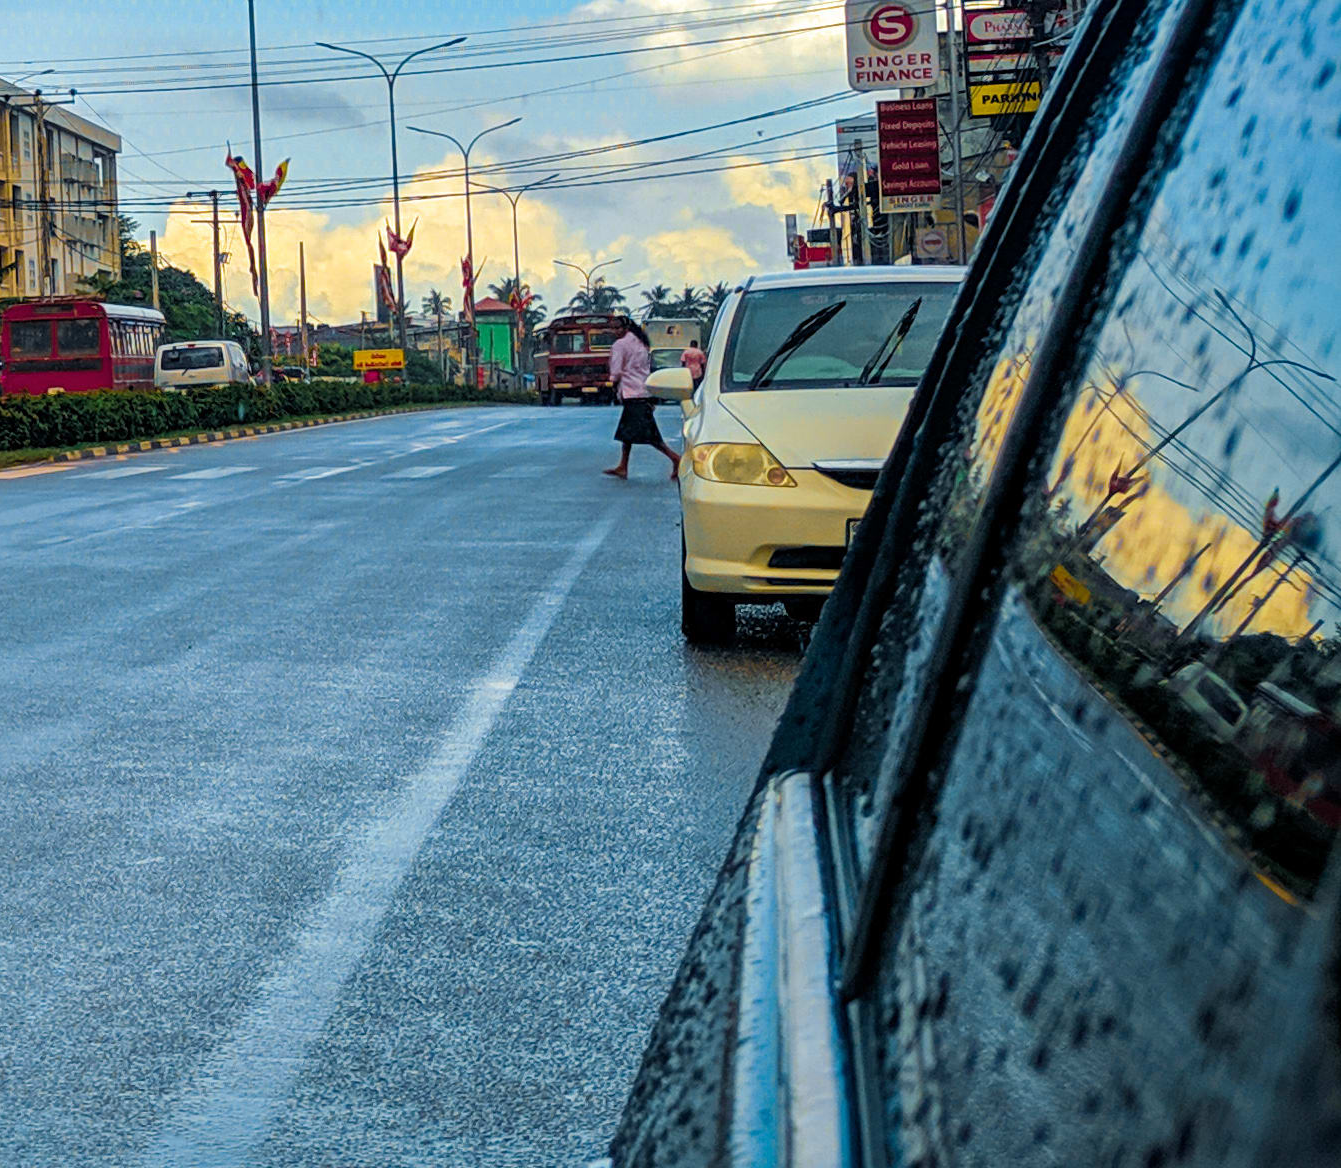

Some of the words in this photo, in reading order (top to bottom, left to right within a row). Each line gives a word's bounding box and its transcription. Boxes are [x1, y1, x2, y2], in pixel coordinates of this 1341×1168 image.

[855, 53, 931, 68] SINGER
[856, 68, 933, 83] FINANCE
[880, 103, 911, 112] Business
[912, 102, 933, 110] Loans
[881, 122, 901, 130] Fixed
[903, 120, 935, 130] Deposits
[881, 141, 907, 150] Vehicle
[909, 140, 937, 150] Leasing
[892, 162, 909, 170] Gold
[911, 161, 929, 169] Loan
[883, 180, 907, 190] Savings
[909, 180, 939, 188] Accounts
